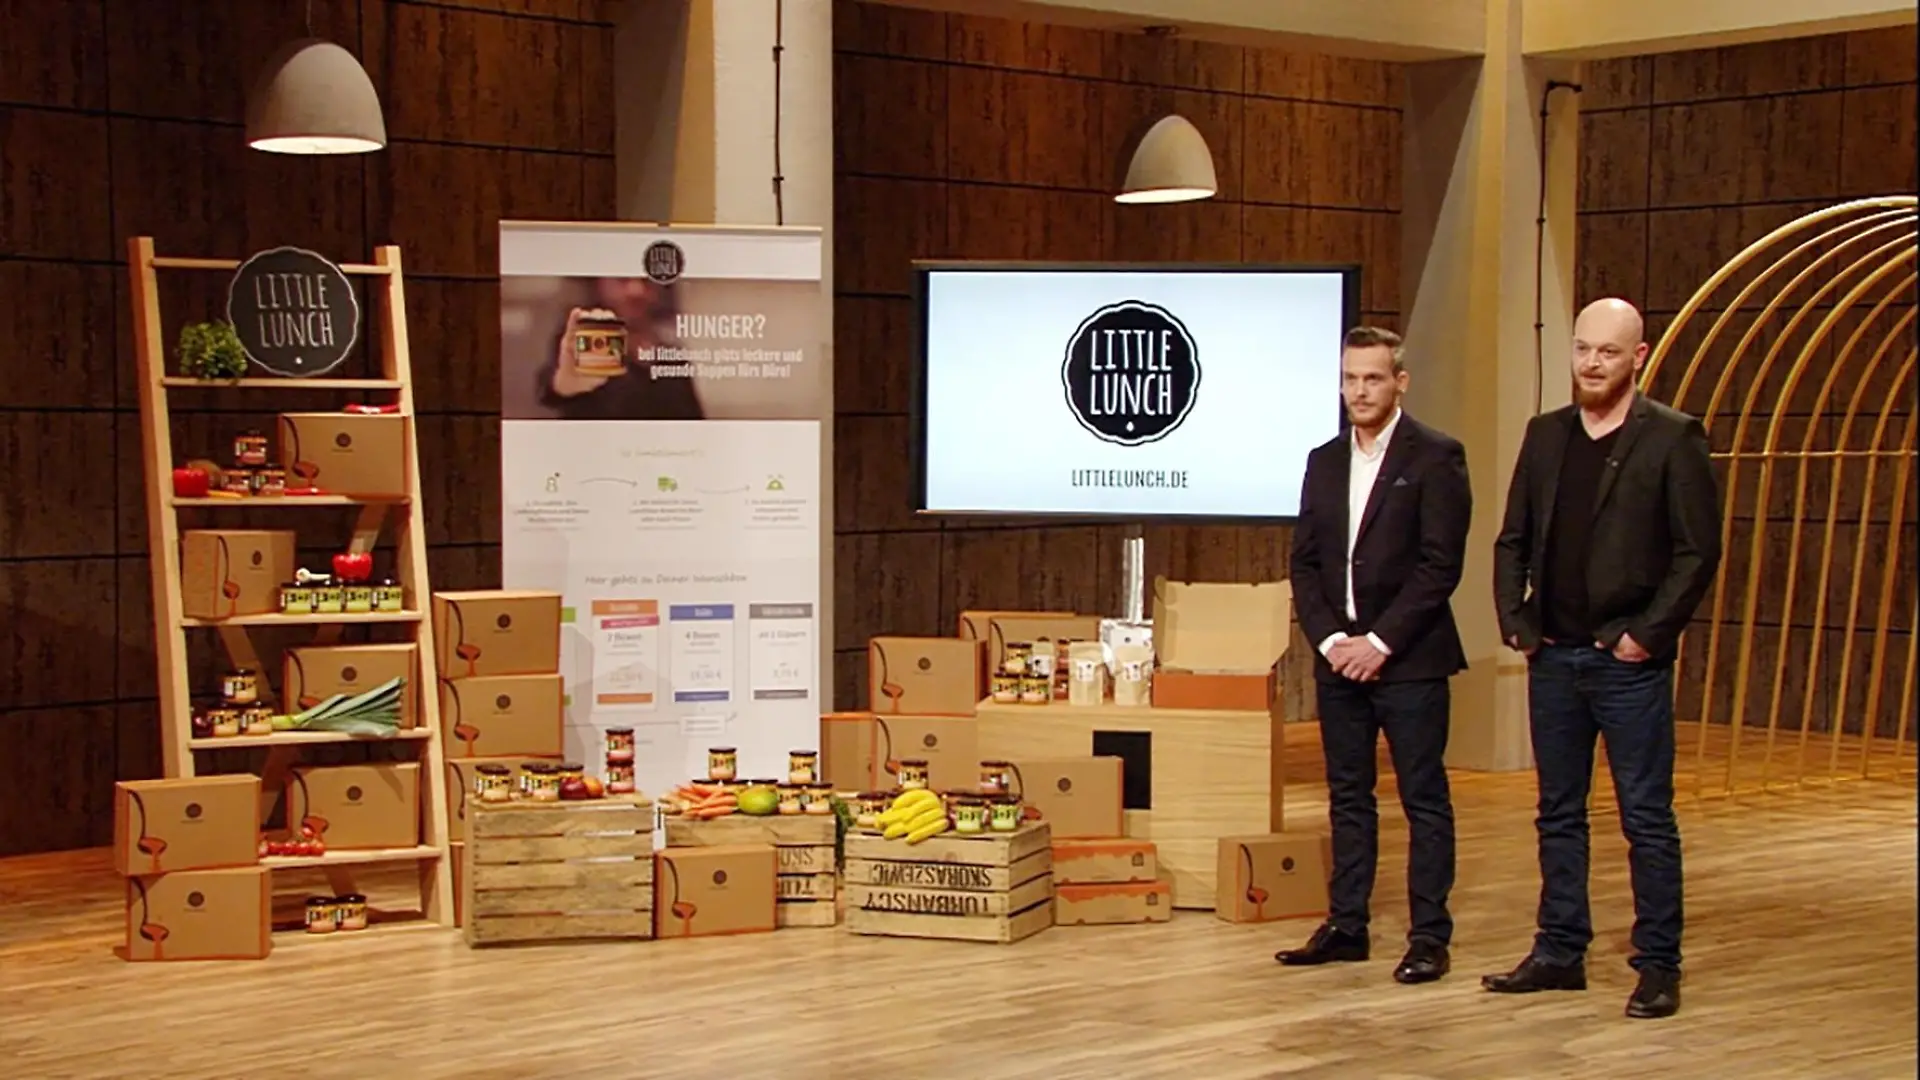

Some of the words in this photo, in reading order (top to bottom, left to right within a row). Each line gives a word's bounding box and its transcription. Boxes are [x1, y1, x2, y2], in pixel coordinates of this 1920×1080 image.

[255, 273, 330, 310] LITTLE
[259, 311, 335, 348] LUNCH
[676, 314, 766, 339] HUNGER?
[1089, 329, 1173, 371] LITTLE
[1089, 372, 1173, 416] LUNCH
[1071, 468, 1190, 490] LITTLELUNCH.DE
